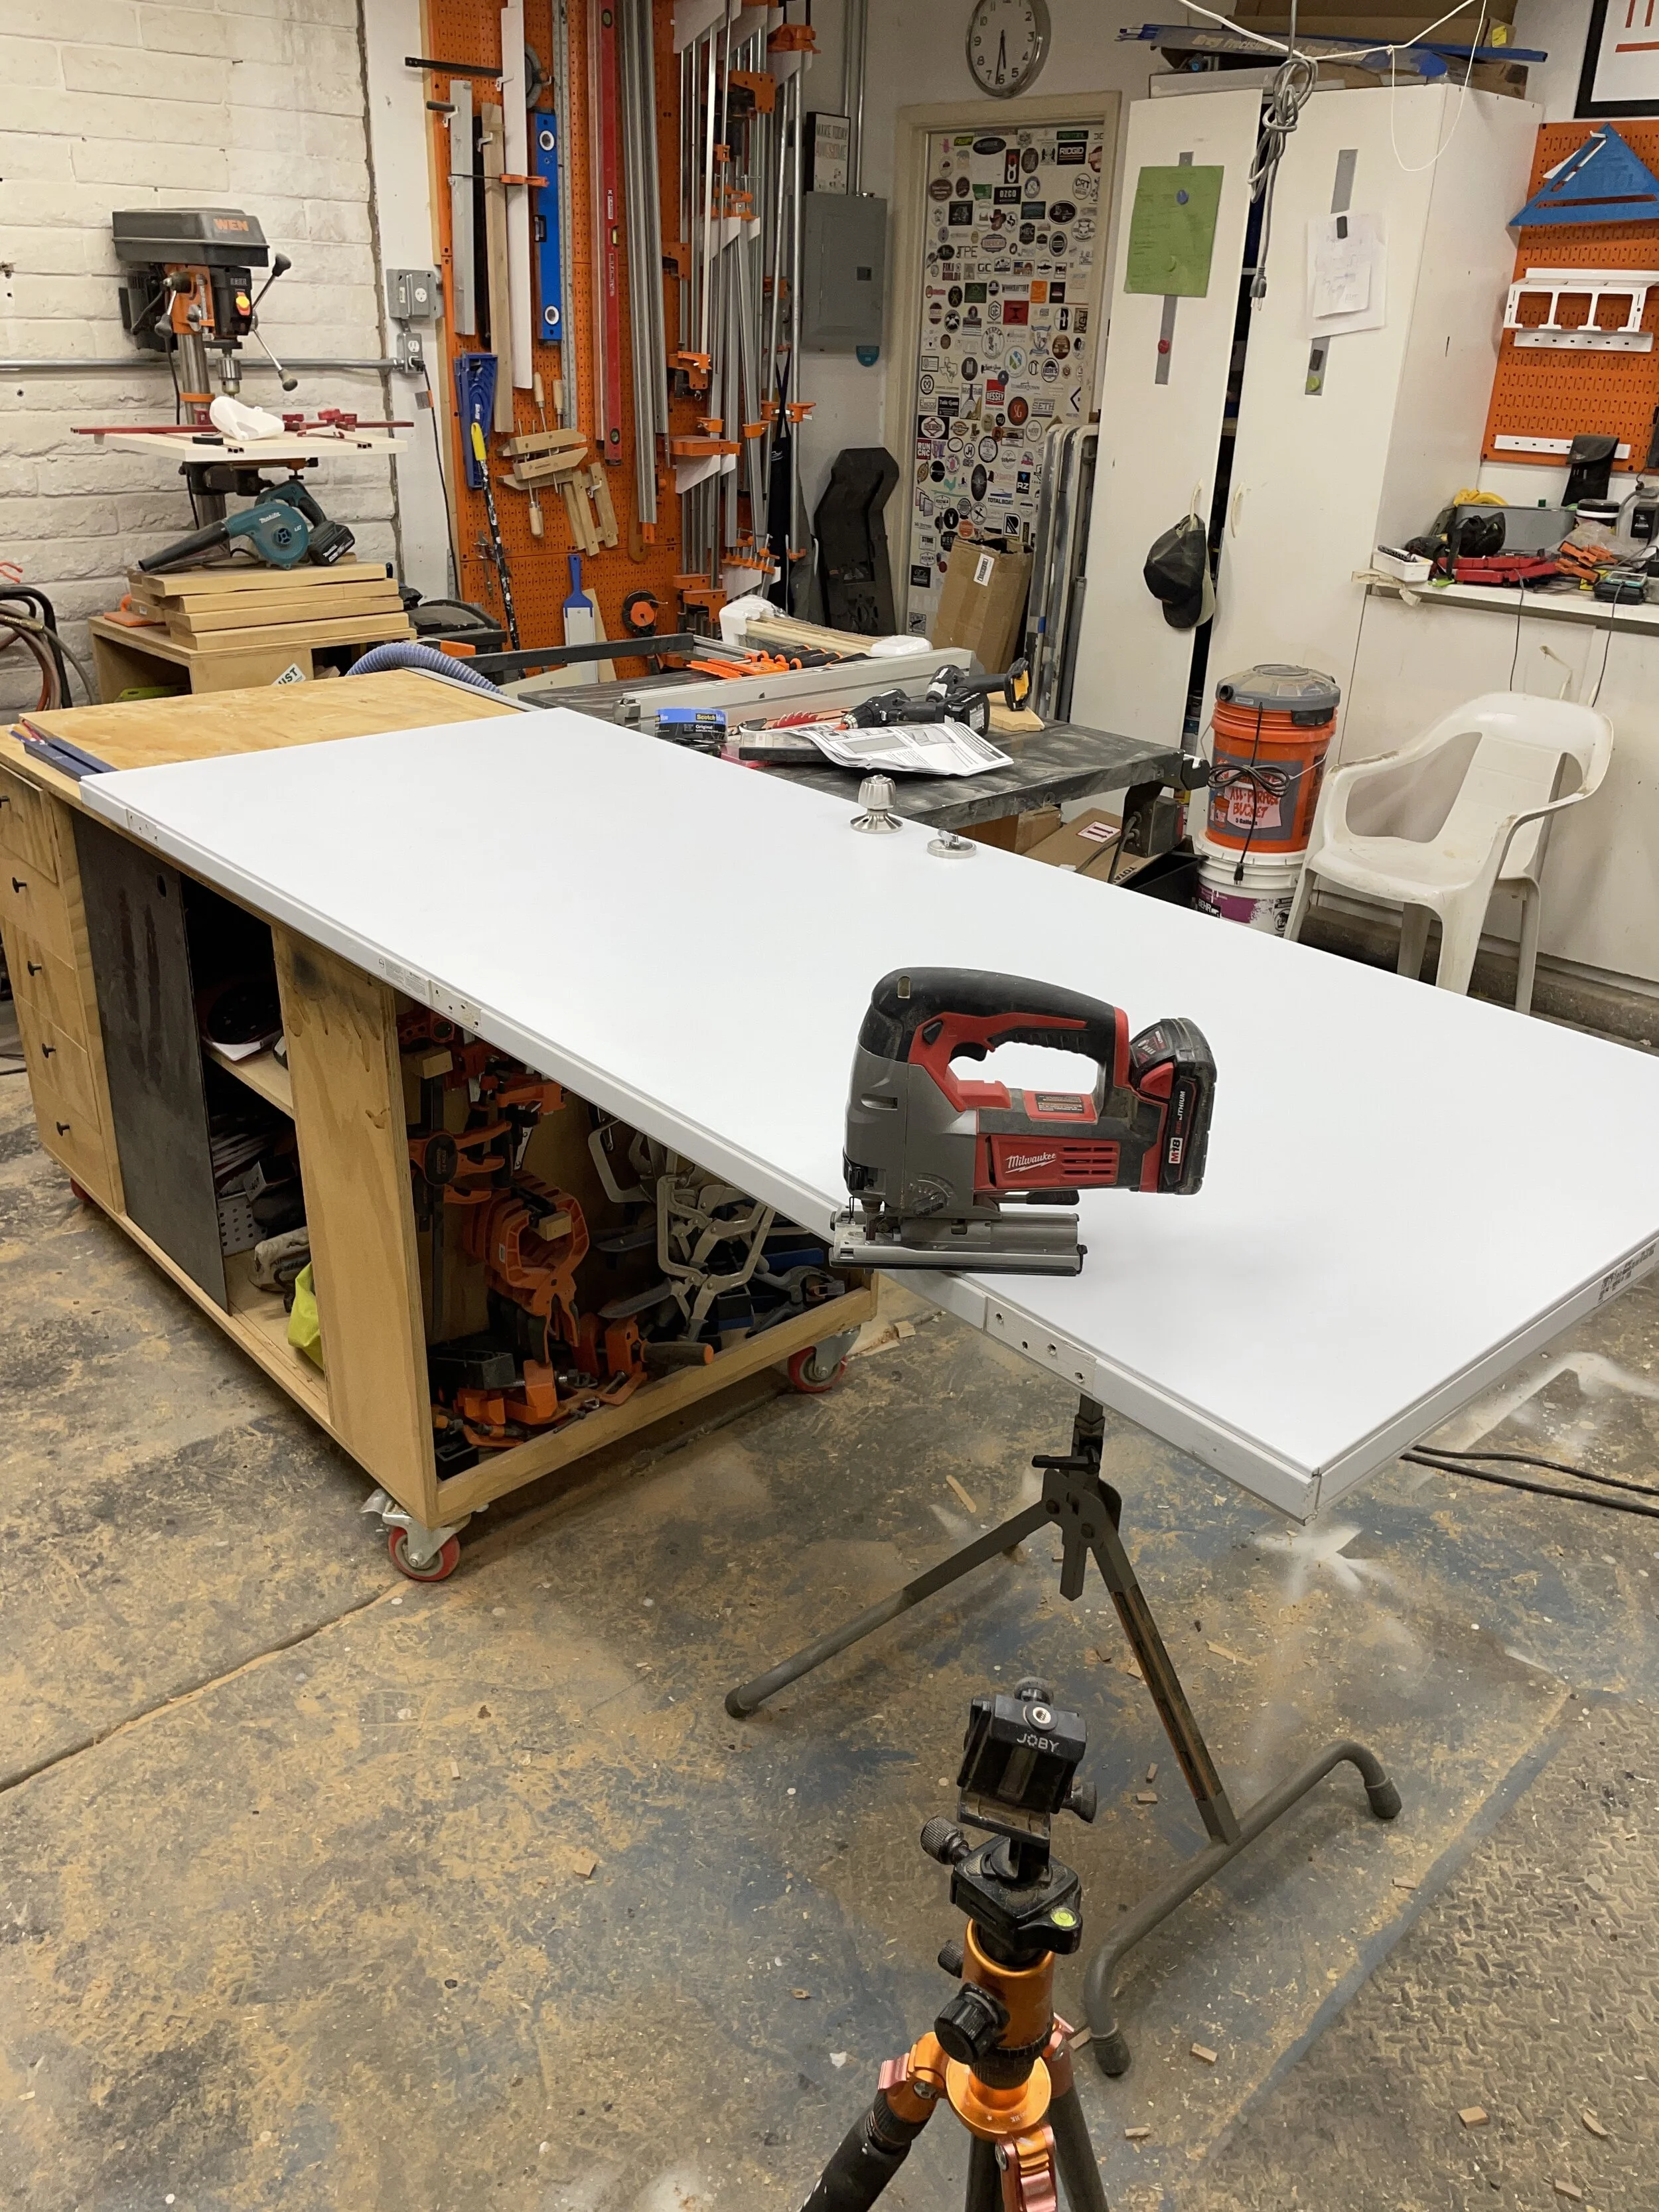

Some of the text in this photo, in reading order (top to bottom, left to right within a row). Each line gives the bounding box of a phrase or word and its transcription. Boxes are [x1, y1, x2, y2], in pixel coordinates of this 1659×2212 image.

[1025, 11, 1032, 21] 2
[980, 17, 987, 26] 10
[974, 37, 981, 46] 9
[1027, 32, 1035, 42] 3
[977, 56, 985, 65] 8
[1023, 52, 1029, 61] 4
[986, 70, 992, 80] 7
[1012, 68, 1019, 78] 5
[998, 74, 1005, 84] 6
[213, 218, 249, 232] WEN
[1171, 1139, 1181, 1162] M18
[1006, 1151, 1056, 1169] Milwaukee
[1016, 1733, 1060, 1753] JOBY
